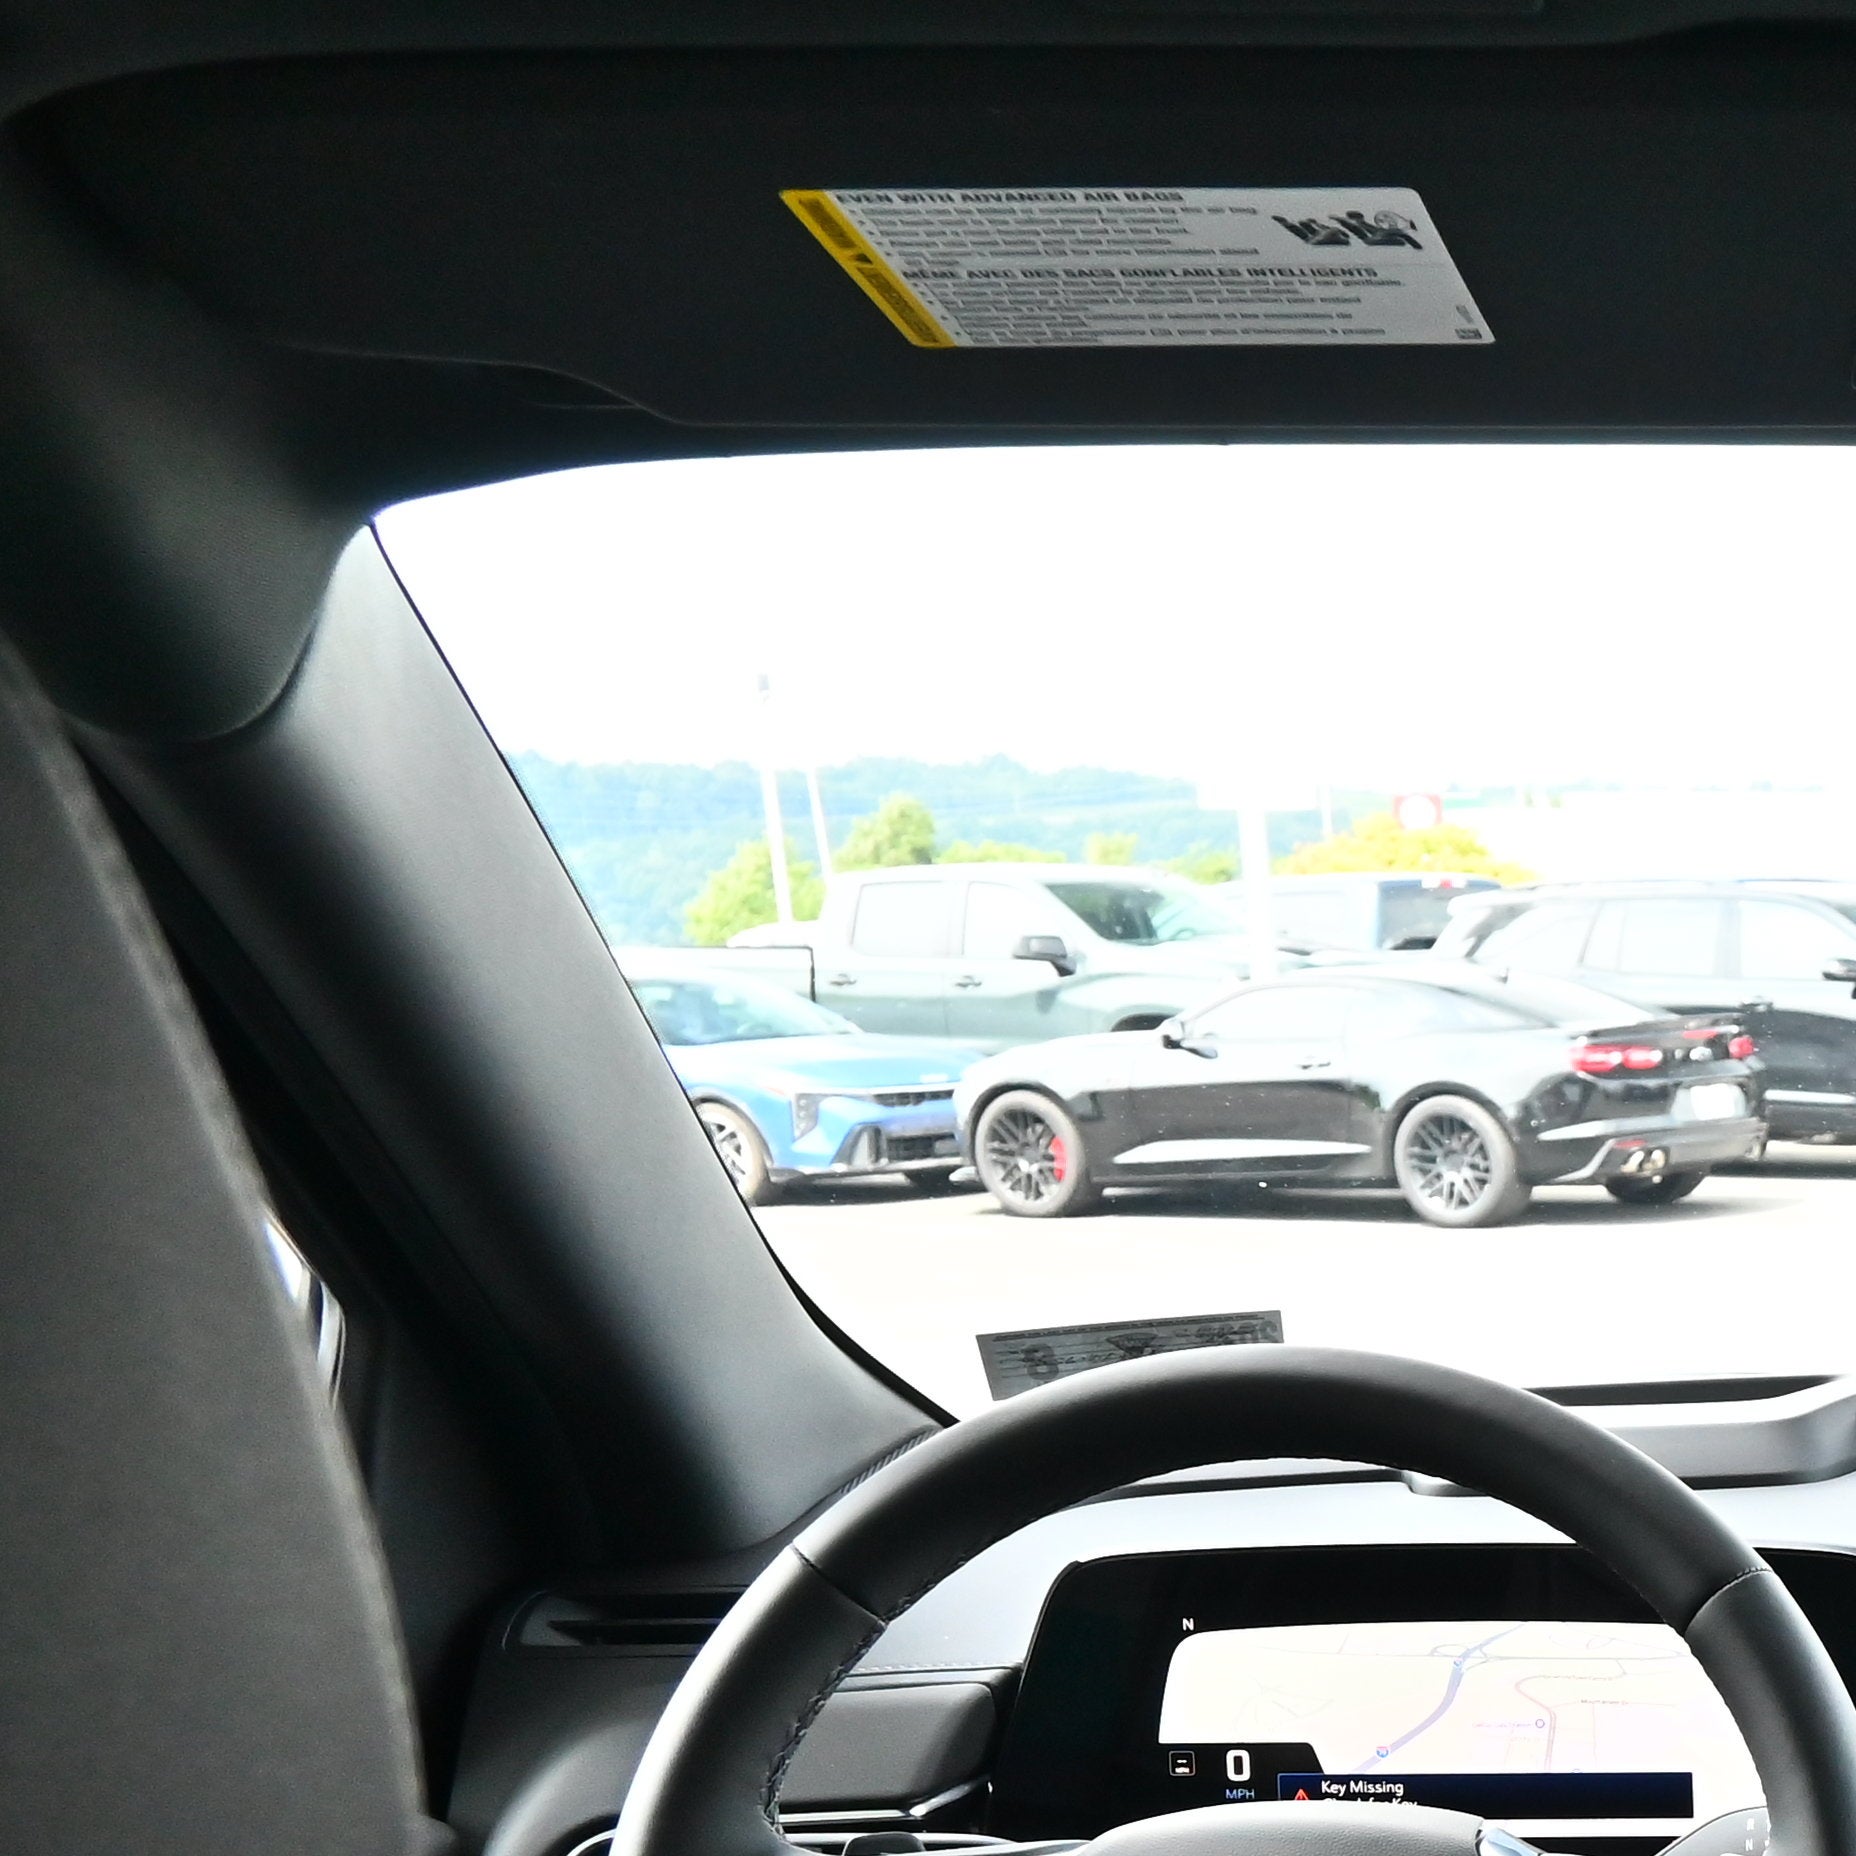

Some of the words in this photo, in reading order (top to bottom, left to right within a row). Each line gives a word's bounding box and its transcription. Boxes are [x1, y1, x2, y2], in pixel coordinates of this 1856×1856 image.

[1182, 1617, 1194, 1631] N
[1226, 1749, 1251, 1782] 0
[1225, 1788, 1255, 1800] MPH
[1321, 1780, 1347, 1797] Key
[1350, 1780, 1404, 1796] Missing
[1745, 1838, 1753, 1851] N
